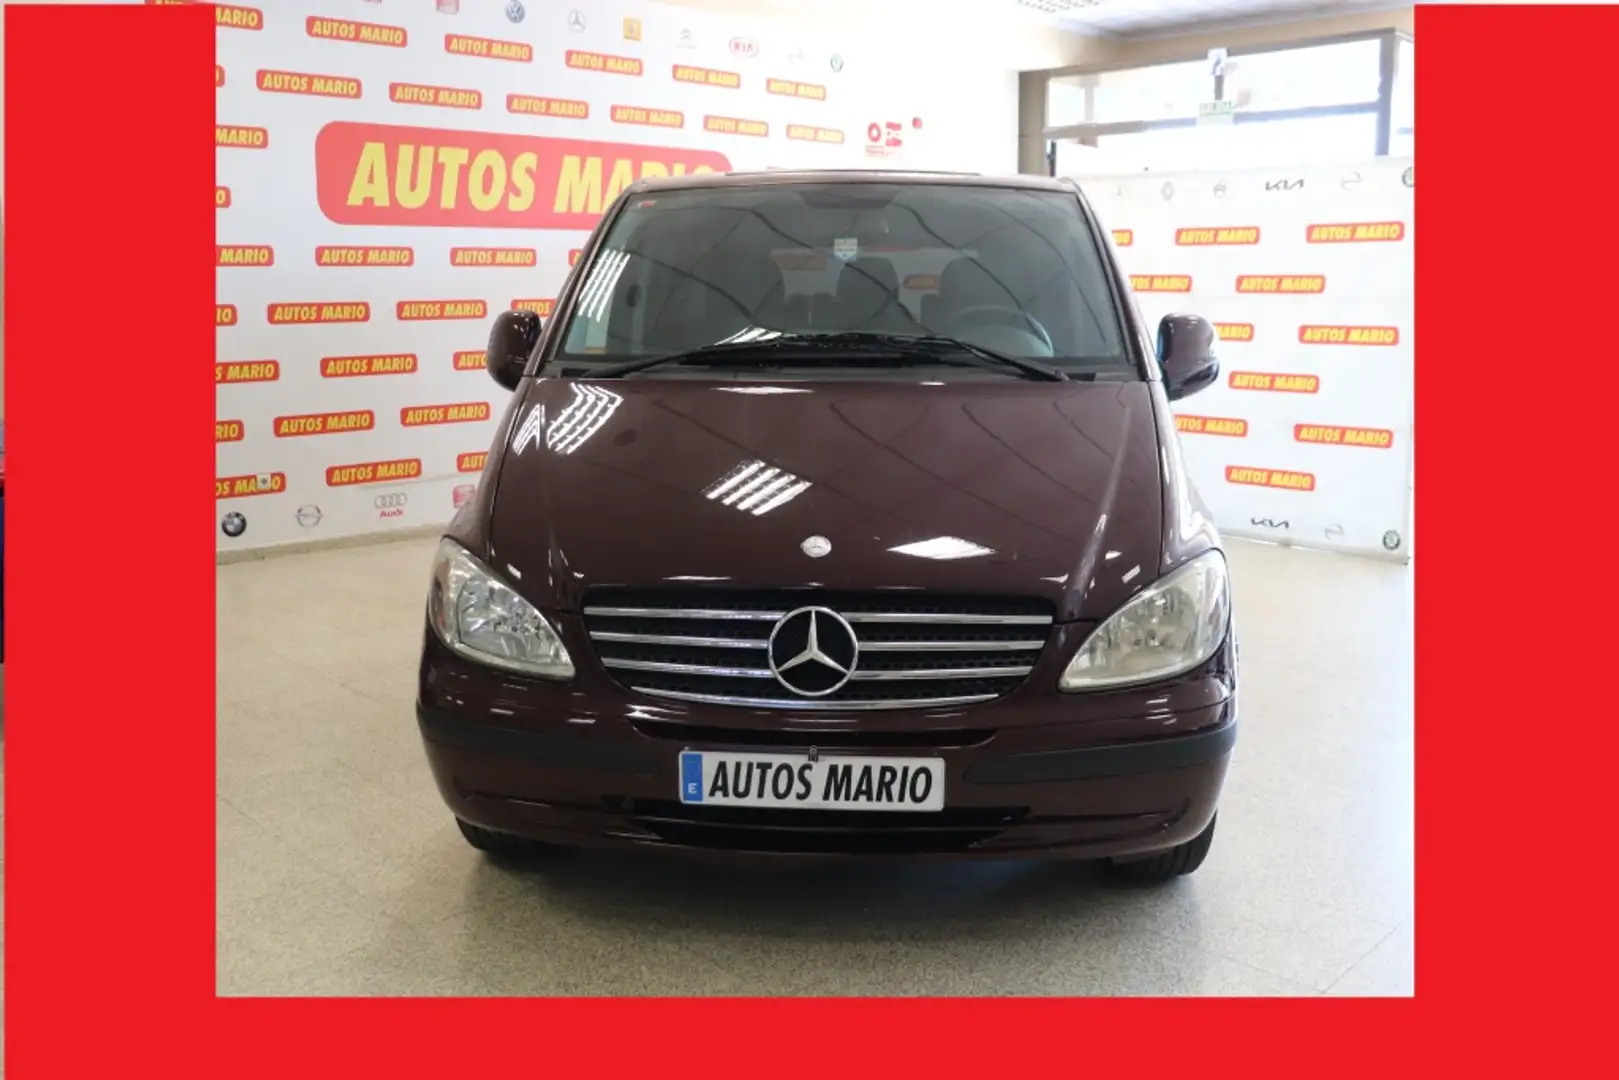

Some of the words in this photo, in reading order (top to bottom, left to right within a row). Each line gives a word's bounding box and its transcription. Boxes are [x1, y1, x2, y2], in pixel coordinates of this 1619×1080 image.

[312, 20, 356, 39] AUTOS
[360, 25, 403, 44] MARIO
[450, 37, 488, 55] AUTOS
[491, 43, 529, 60] MARIO
[570, 53, 603, 69] AUTOS
[606, 57, 640, 73] MARIO
[263, 73, 307, 91] AUTOS
[312, 78, 357, 96] MARIO
[395, 86, 434, 102] AUTOS
[438, 89, 478, 106] MARIO
[511, 96, 547, 113] AUTOS
[550, 100, 586, 117] MARIO
[615, 107, 647, 123] AUTOS
[650, 111, 682, 126] MARIO
[346, 141, 537, 212] AUTOS
[1179, 230, 1214, 244] AUTOS
[1217, 229, 1257, 243] MARIO
[1312, 225, 1351, 240] AUTOS
[1354, 223, 1400, 240] MARIO
[220, 248, 269, 264] MARIO
[321, 249, 363, 263] AUTOS
[367, 249, 409, 264] MARIO
[456, 250, 492, 265] AUTOS
[495, 251, 533, 265] MARIO
[1240, 278, 1278, 291] AUTOS
[1281, 278, 1322, 291] MARIO
[274, 306, 317, 321] AUTOS
[321, 304, 365, 320] MARIO
[401, 303, 442, 318] AUTOS
[444, 302, 483, 317] MARIO
[1304, 327, 1346, 342] AUTOS
[1349, 329, 1394, 343] MARIO
[227, 364, 274, 380] MARIO
[326, 359, 368, 375] AUTOS
[372, 356, 413, 372] MARIO
[1234, 374, 1271, 388] AUTOS
[1274, 376, 1316, 391] MARIO
[406, 407, 443, 423] AUTOS
[447, 405, 486, 420] MARIO
[280, 418, 322, 435] AUTOS
[326, 414, 370, 431] MARIO
[1204, 419, 1244, 434] MARIO
[1299, 428, 1340, 442] AUTOS
[1343, 430, 1389, 445] MARIO
[332, 466, 372, 482] AUTOS
[376, 462, 418, 478] MARIO
[1230, 468, 1267, 484] AUTOS
[1271, 471, 1311, 488] MARIO
[380, 508, 403, 518] Audi
[688, 783, 698, 794] E
[708, 760, 813, 801] AUTOS
[822, 764, 933, 804] MARIO
